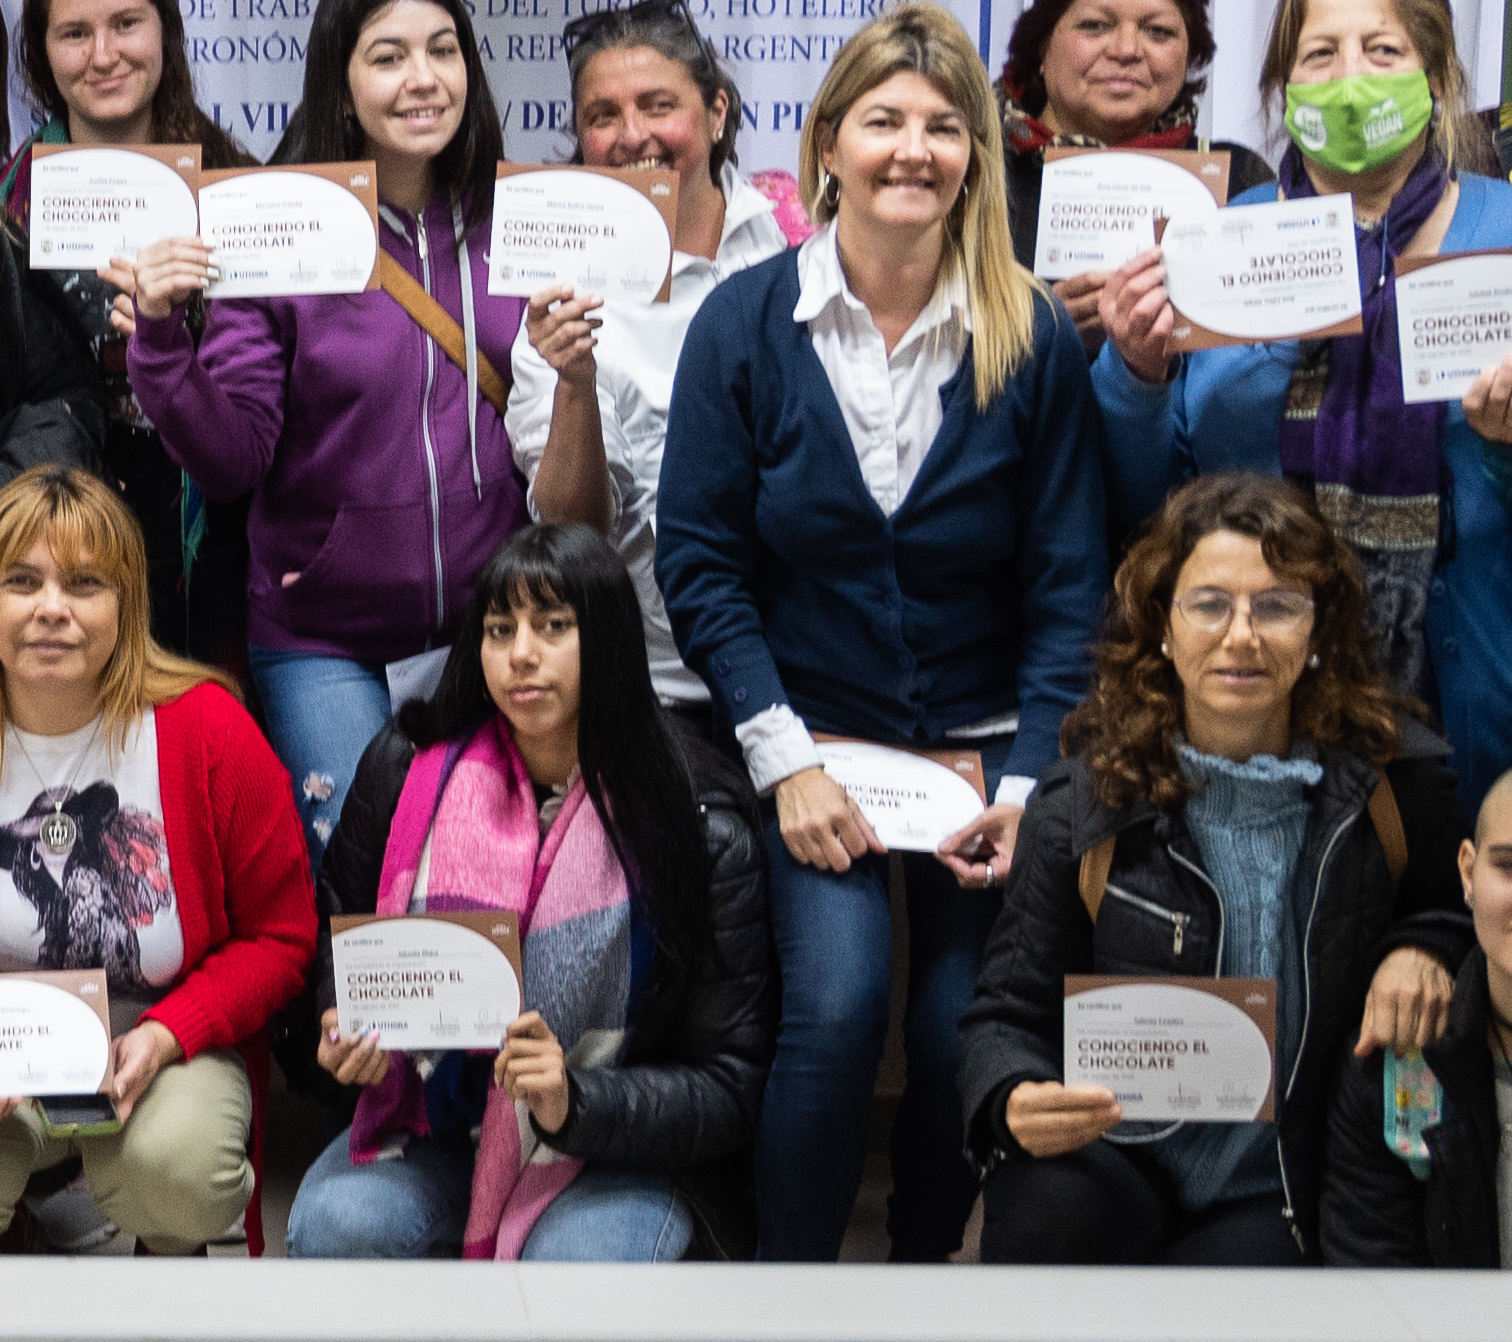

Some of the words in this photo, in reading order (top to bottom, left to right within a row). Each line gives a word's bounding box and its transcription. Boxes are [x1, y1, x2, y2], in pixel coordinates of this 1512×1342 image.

[42, 196, 131, 209] CONOCIENDO
[135, 198, 148, 210] EL
[1051, 203, 1148, 218] CONOCIENDO
[42, 210, 120, 223] CHOCOLATE
[212, 221, 305, 236] CONOCIENDO
[309, 220, 323, 232] EL
[504, 220, 599, 236] CONOCIENDO
[603, 225, 617, 237] EL
[1050, 218, 1135, 231] CHOCOLATE
[503, 234, 586, 250] CHOCOLATE
[1250, 247, 1342, 269] CHOCOLATE
[1218, 274, 1235, 288] EL
[1240, 263, 1344, 284] CONOCIENDO
[1414, 327, 1512, 348] CHOCOLATE
[347, 970, 445, 986] CONOCIENDO
[449, 970, 464, 983] EL
[348, 986, 434, 1000] CHOCOLATE
[38, 1025, 53, 1037] EL
[1078, 1039, 1188, 1053] CONOCIENDO
[1193, 1040, 1209, 1055] EL
[1078, 1056, 1175, 1070] CHOCOLATE
